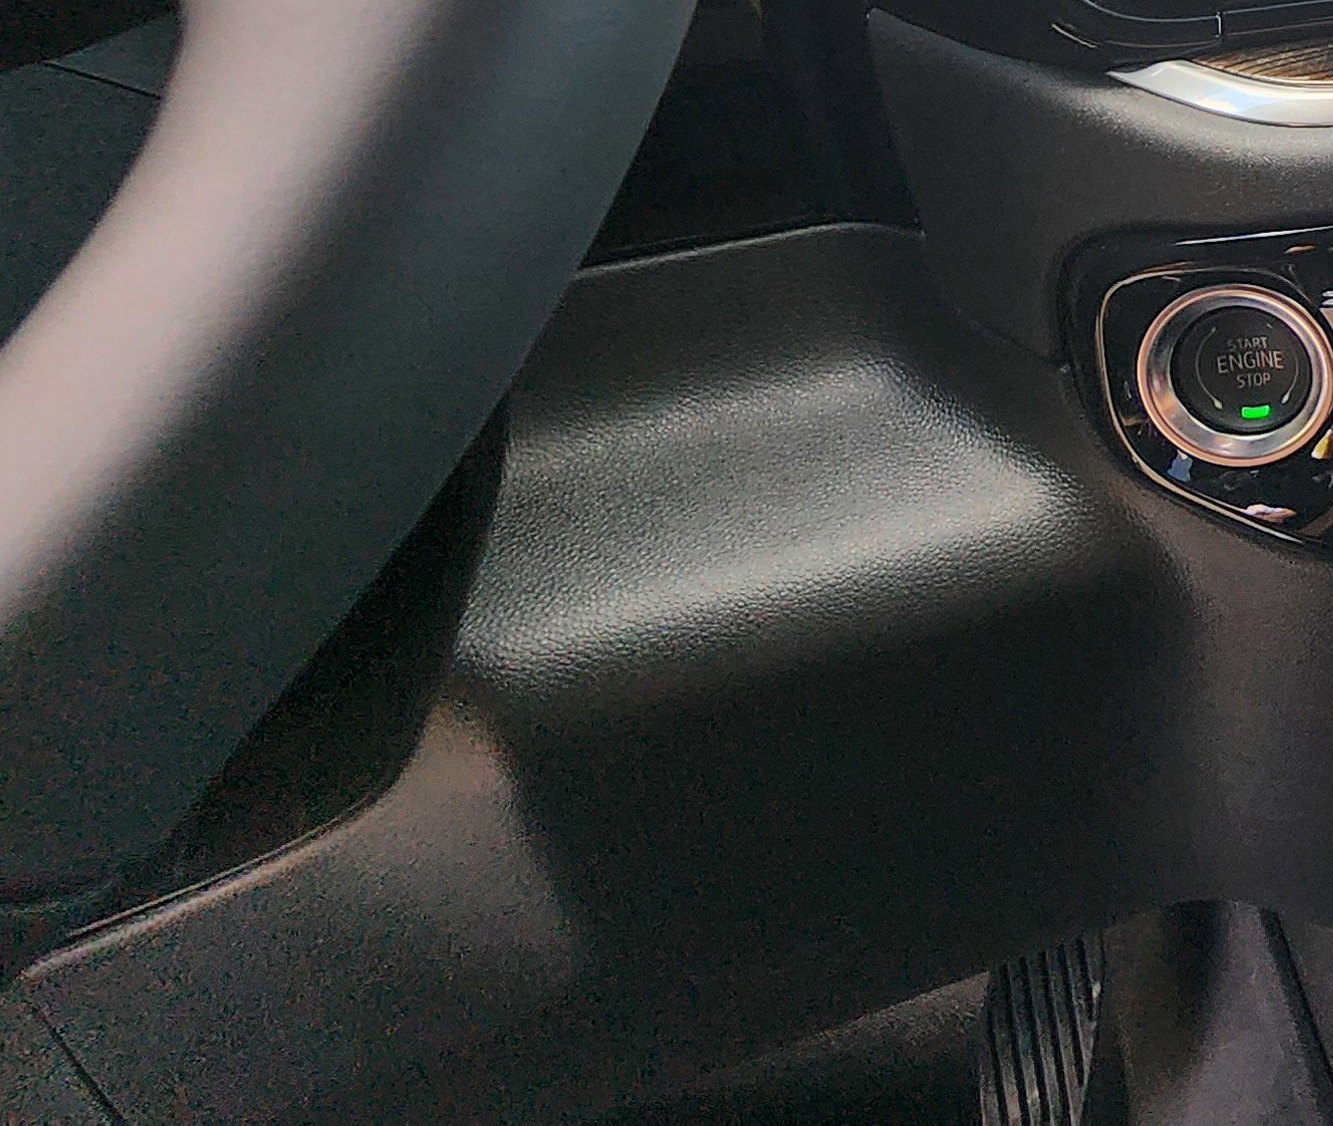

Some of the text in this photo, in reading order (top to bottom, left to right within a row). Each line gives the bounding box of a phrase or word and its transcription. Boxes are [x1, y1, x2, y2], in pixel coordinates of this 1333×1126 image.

[1227, 336, 1268, 352] START
[1217, 350, 1285, 374] ENGINE
[1236, 372, 1272, 389] STOP
